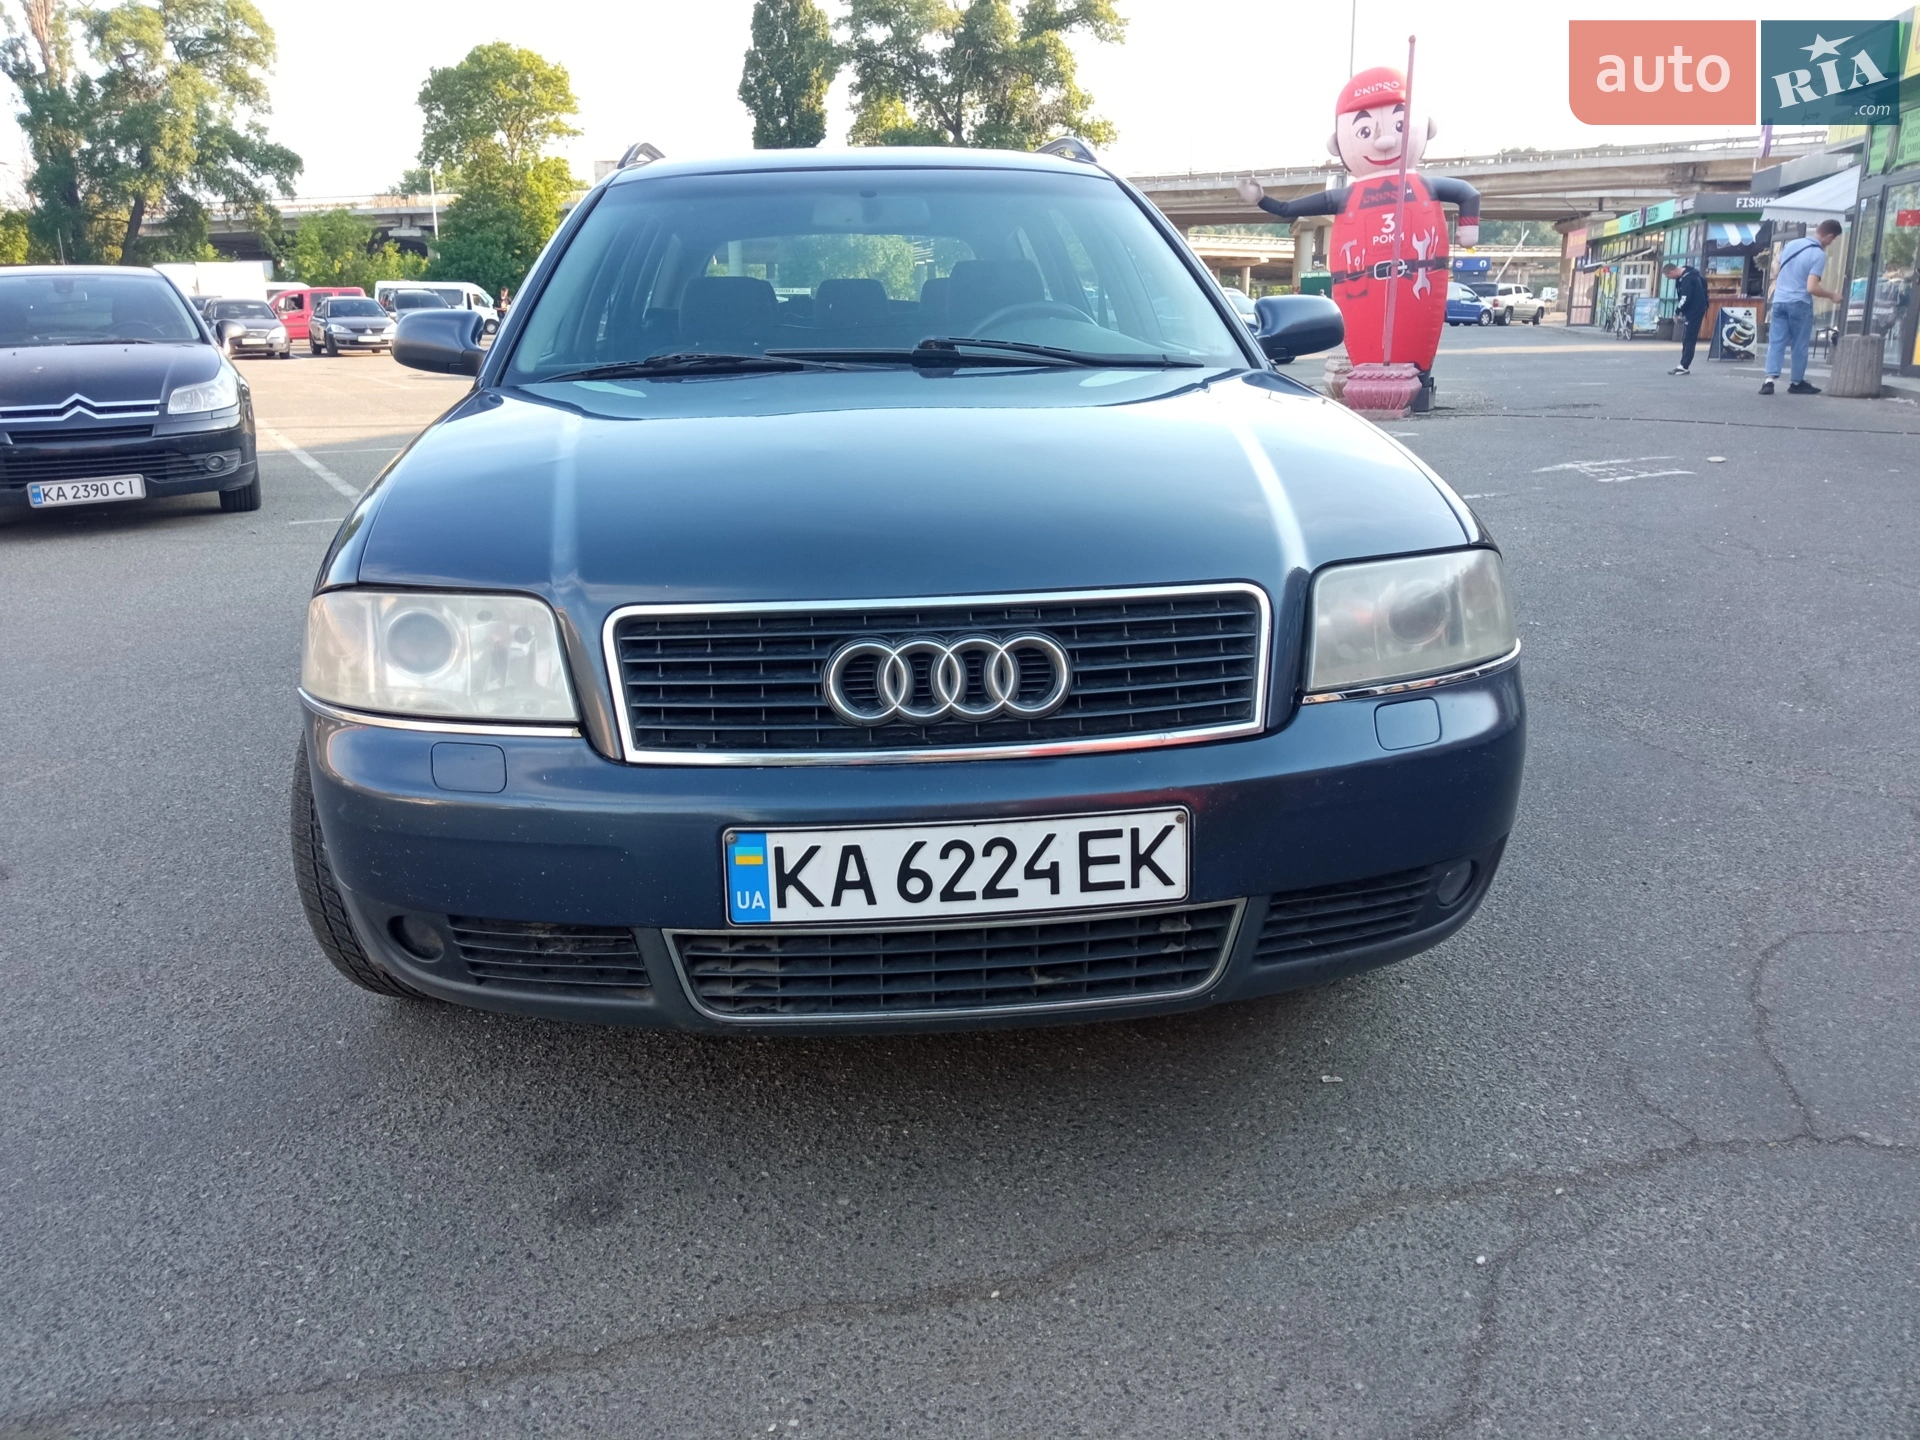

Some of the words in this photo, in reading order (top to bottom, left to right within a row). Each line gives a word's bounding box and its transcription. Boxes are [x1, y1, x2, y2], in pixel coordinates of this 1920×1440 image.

[1354, 80, 1400, 97] DNIPRO
[1380, 213, 1396, 233] 3
[42, 486, 68, 502] KA
[71, 483, 110, 499] 2390
[737, 890, 766, 910] UA
[773, 845, 878, 909] KA
[896, 833, 1060, 904] 6224
[1078, 824, 1176, 893] EK
